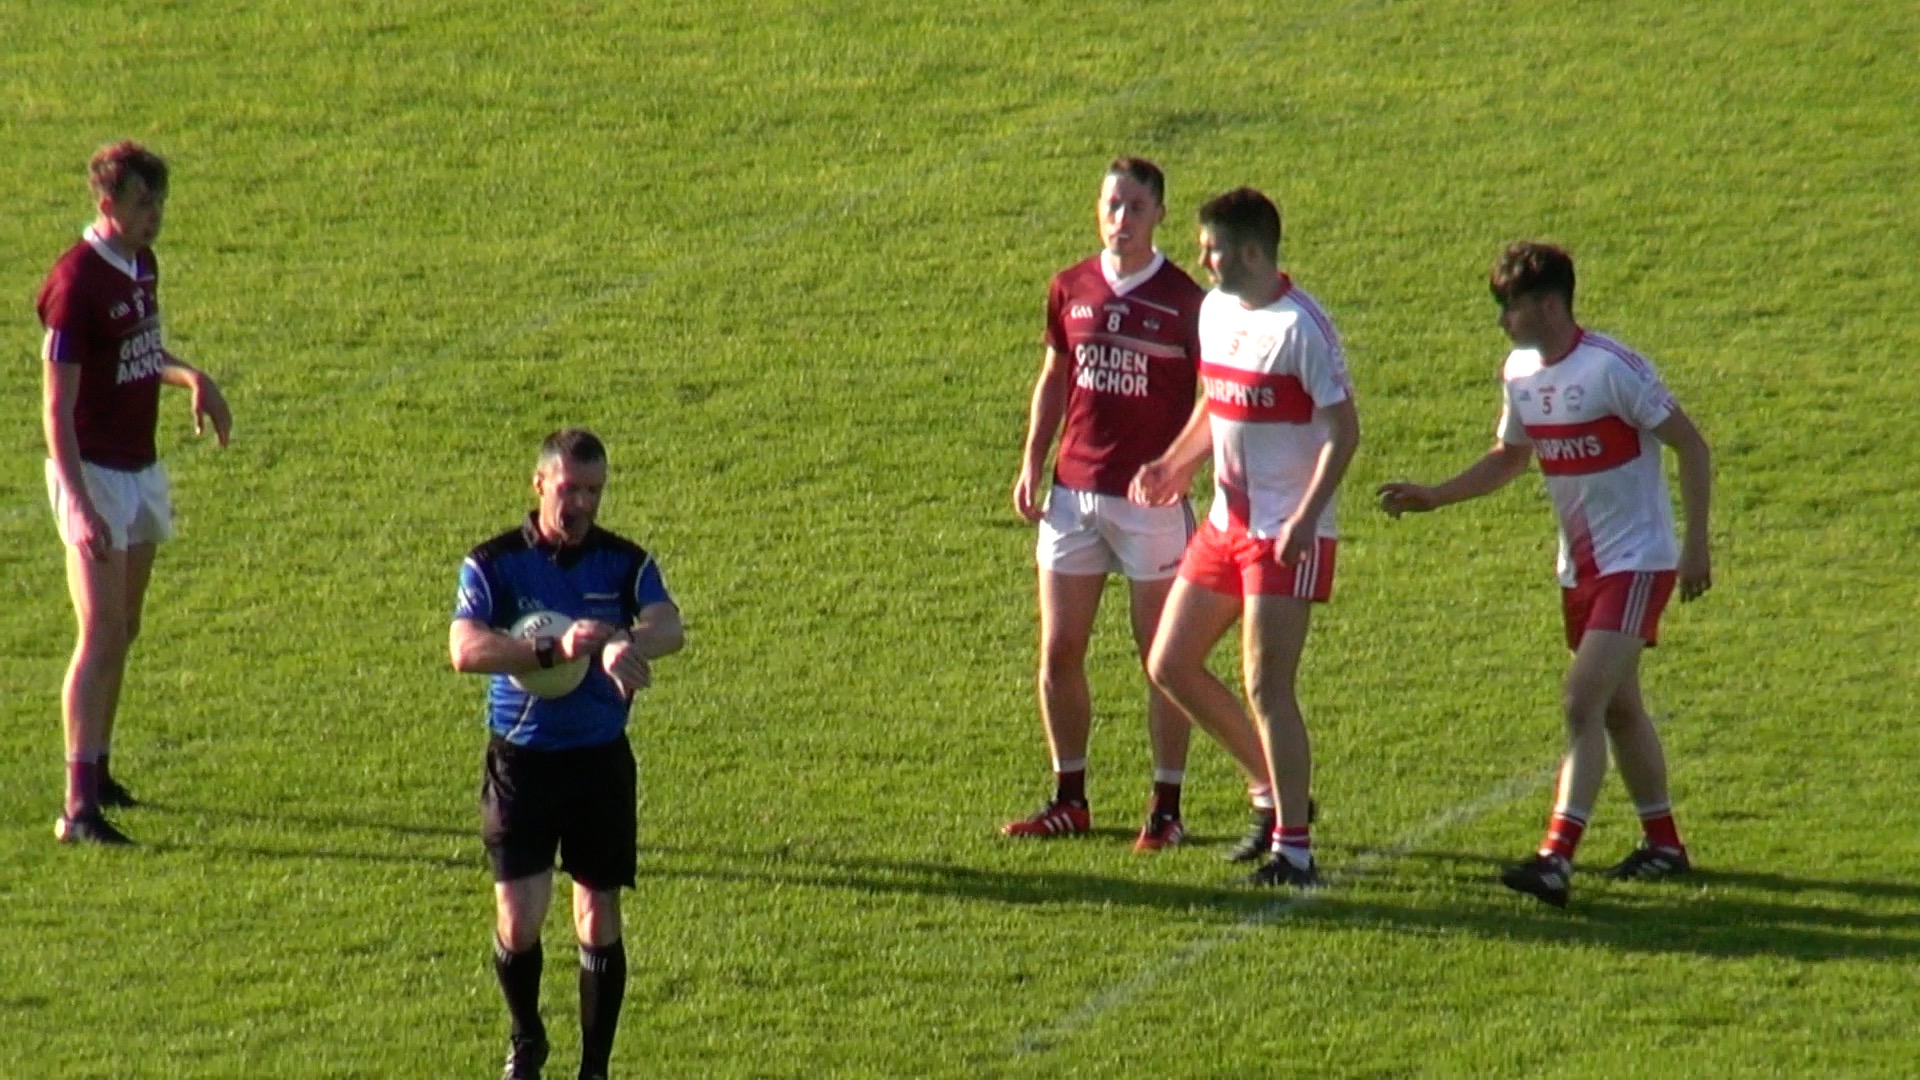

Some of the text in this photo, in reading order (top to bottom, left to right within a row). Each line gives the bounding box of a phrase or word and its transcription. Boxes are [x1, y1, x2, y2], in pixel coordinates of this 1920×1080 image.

[1107, 312, 1121, 332] 8
[1075, 344, 1148, 374] GOLDEN
[1076, 367, 1148, 397] ANCHOR
[1542, 395, 1553, 415] 5
